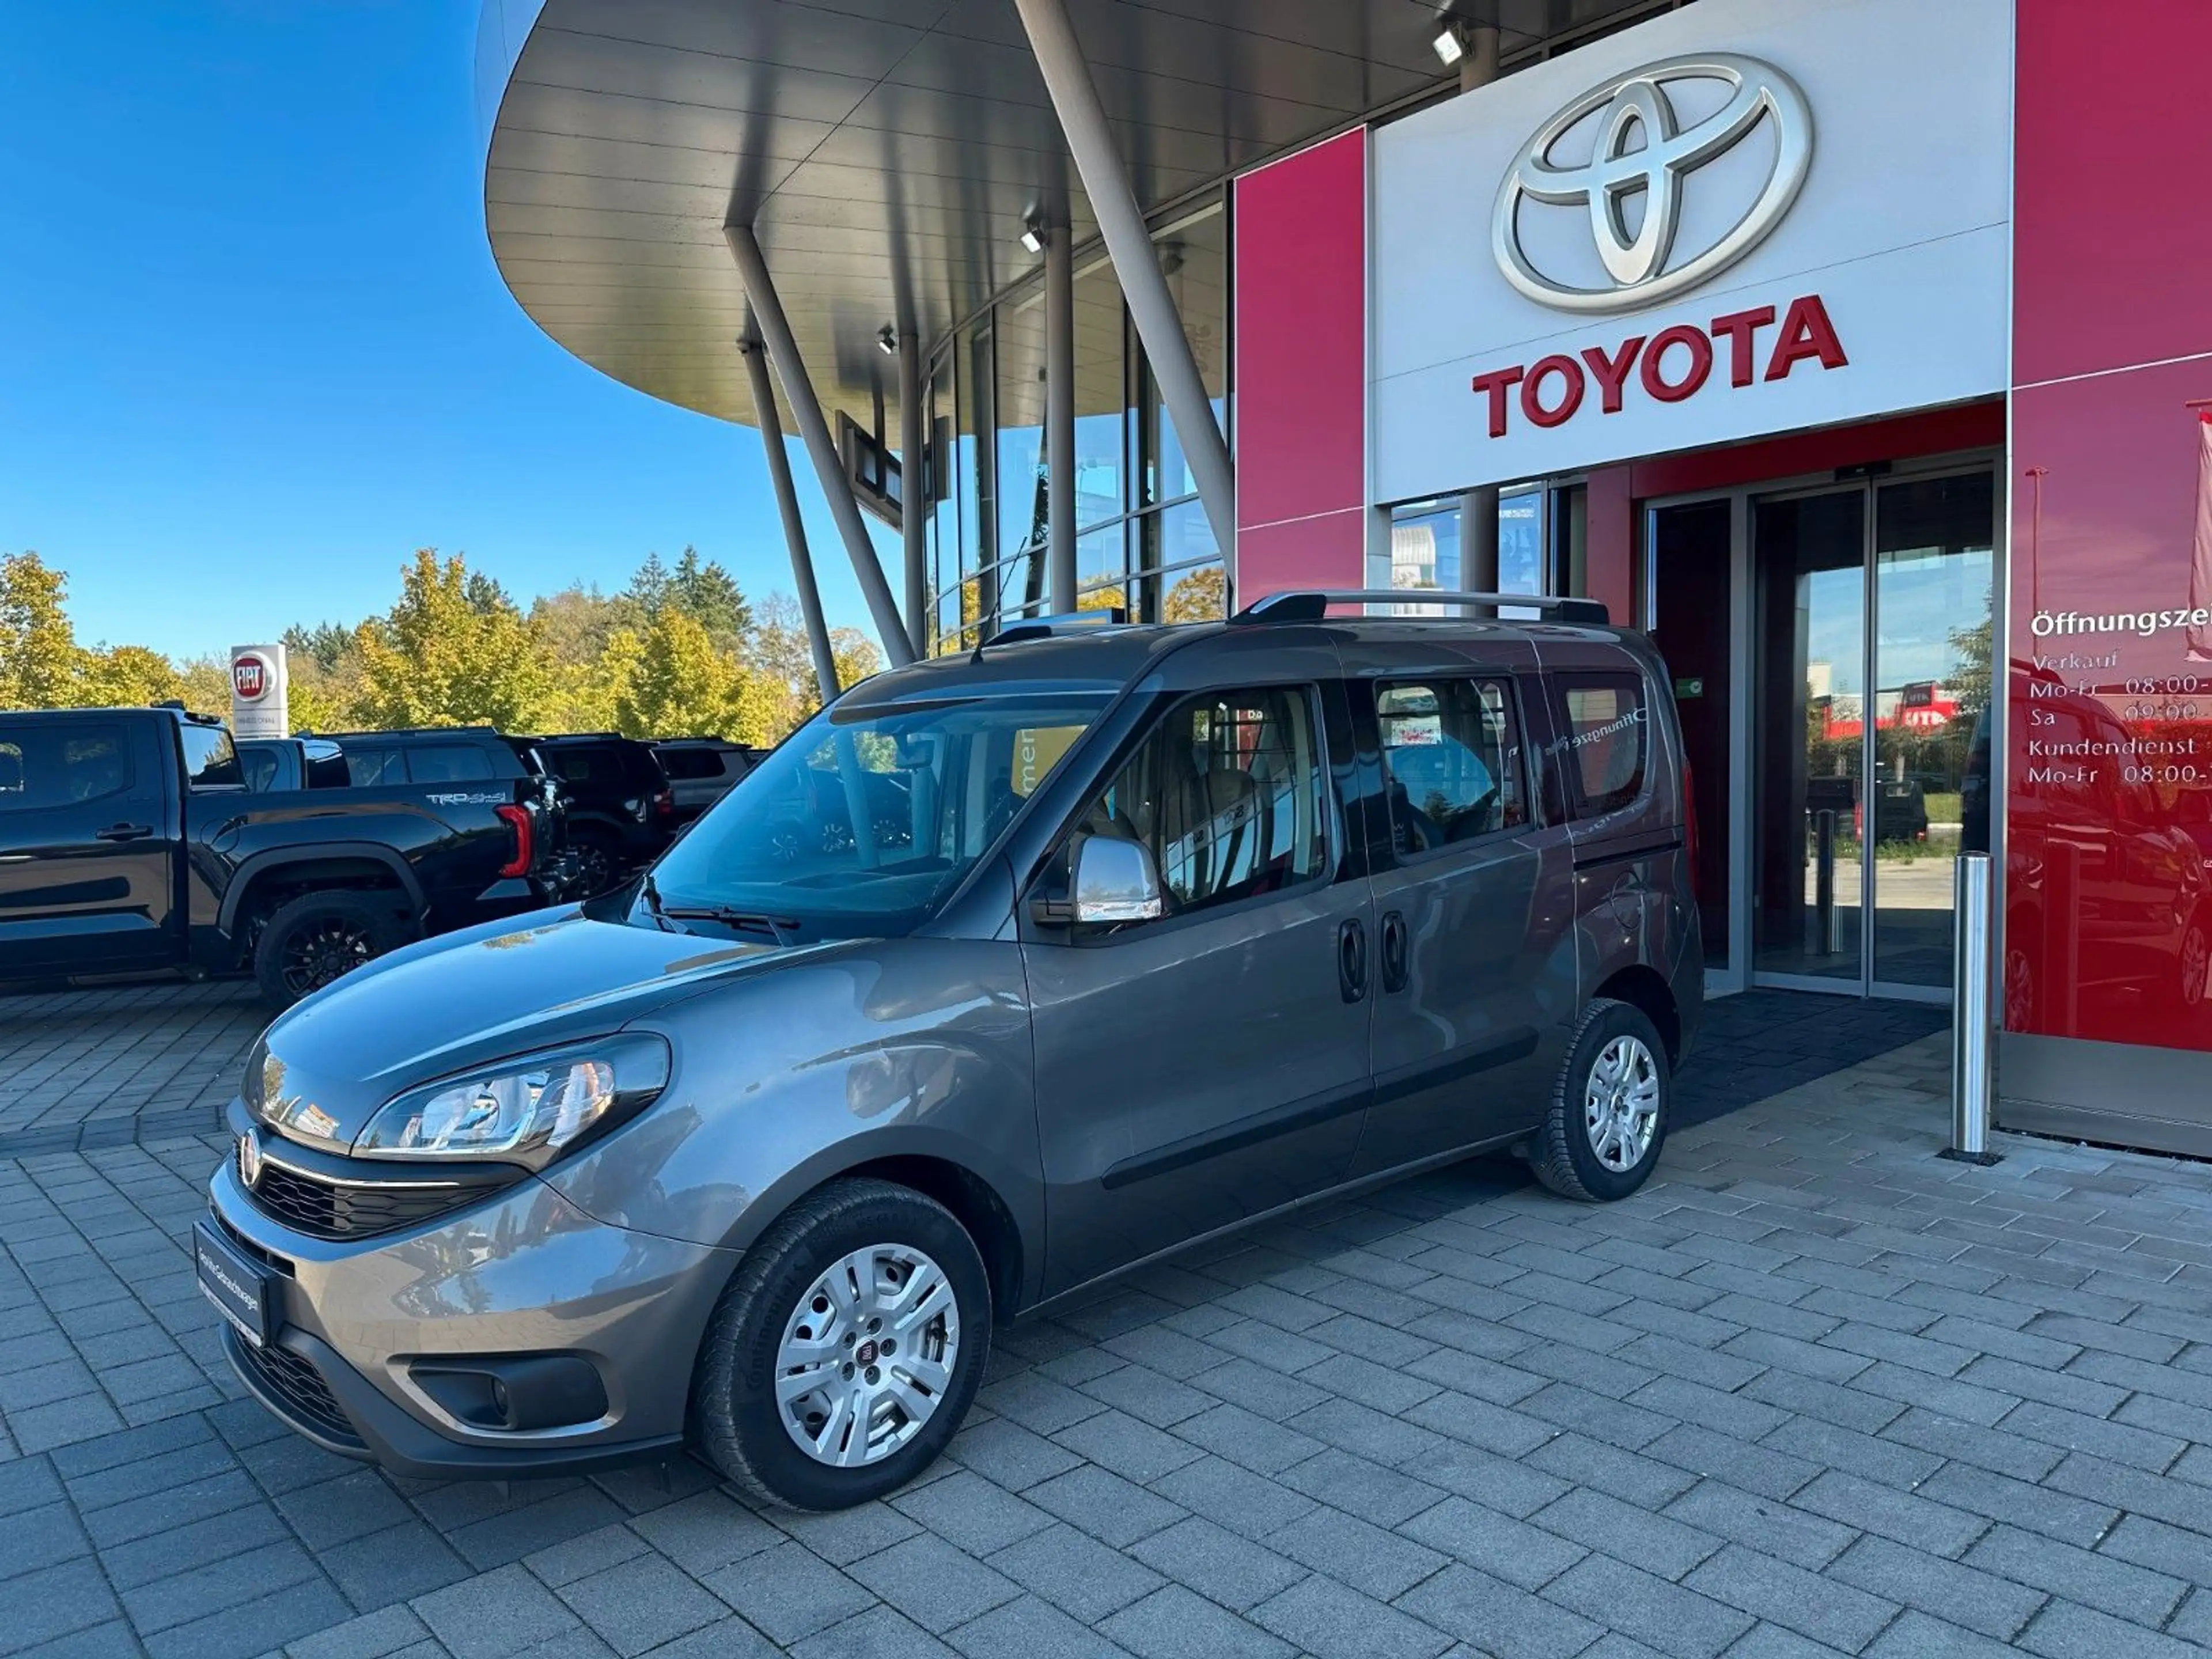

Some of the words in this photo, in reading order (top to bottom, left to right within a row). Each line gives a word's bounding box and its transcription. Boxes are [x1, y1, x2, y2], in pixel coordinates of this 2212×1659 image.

[1472, 294, 1848, 438] TOYOTA
[2032, 649, 2122, 671] Verkauf
[236, 665, 261, 690] FIAT
[2030, 678, 2099, 698] Mo-Fr
[2030, 708, 2056, 726] Sa
[2029, 737, 2198, 756] Kundendienst
[2029, 767, 2098, 784] Mo-Fr
[2124, 764, 2212, 783] 08:00-
[425, 793, 467, 805] TRD
